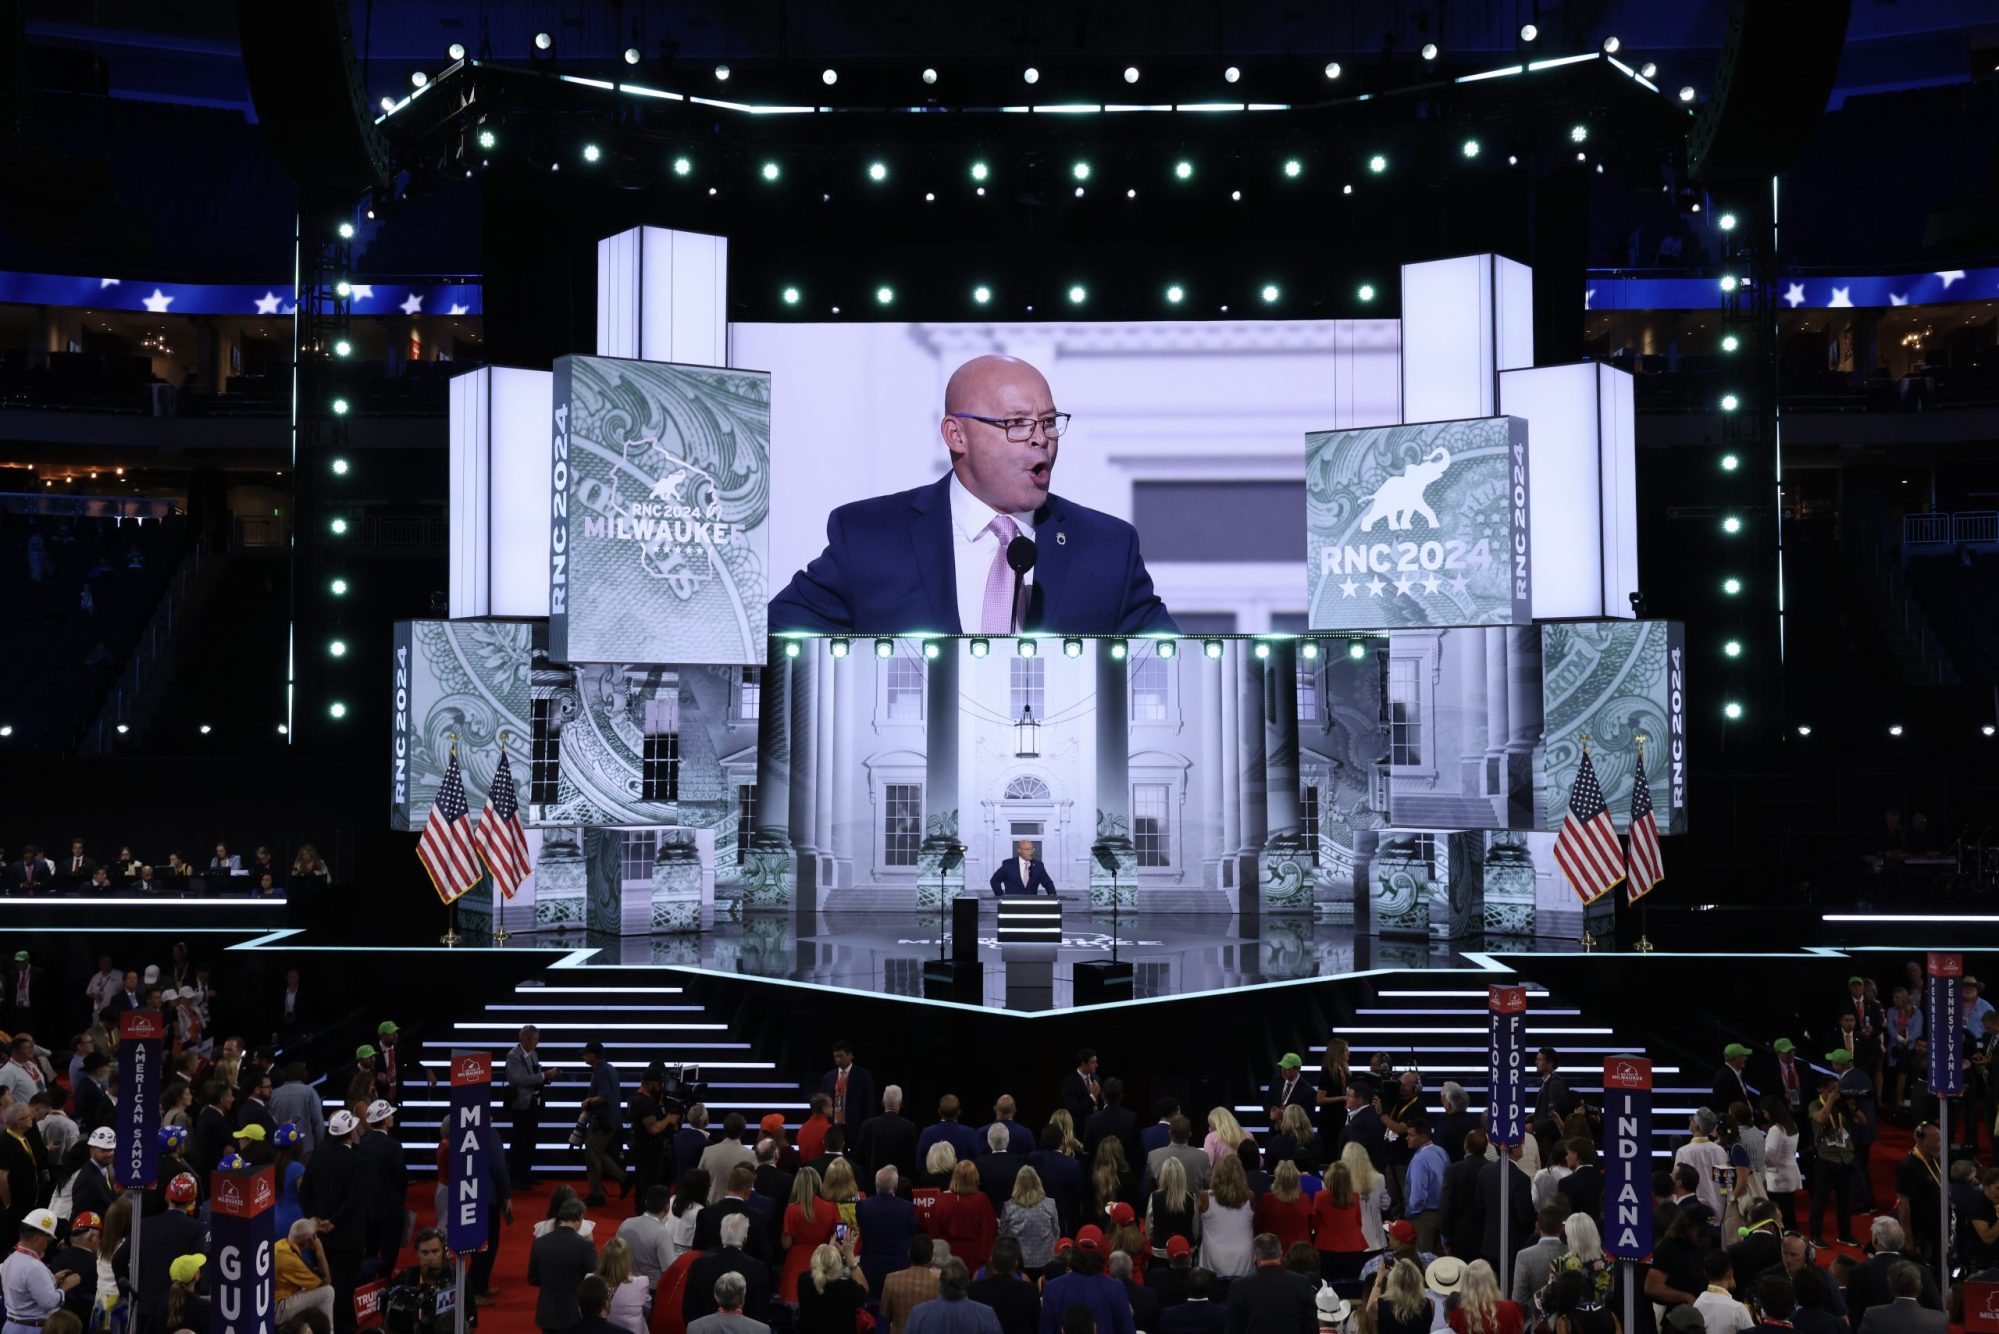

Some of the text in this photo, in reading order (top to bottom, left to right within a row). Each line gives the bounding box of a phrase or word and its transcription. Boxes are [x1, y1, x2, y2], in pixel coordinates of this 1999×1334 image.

[552, 403, 569, 615] RNC 2024
[584, 516, 745, 544] MILWAUKEE
[632, 503, 701, 518] RNC 2024
[1320, 538, 1493, 575] RNC 2024
[1513, 443, 1527, 600] RNC 2024
[395, 646, 407, 804] RNC 2024
[1671, 647, 1683, 808] RNC 2024
[1508, 1016, 1520, 1138] FLORIDA
[1947, 979, 1955, 1090] PENNSYLVANIA
[131, 1043, 146, 1179] AMERICAN SAMOA
[459, 1104, 481, 1226] MAINE
[1618, 1095, 1639, 1248] INDIANA
[220, 1245, 241, 1334] GU
